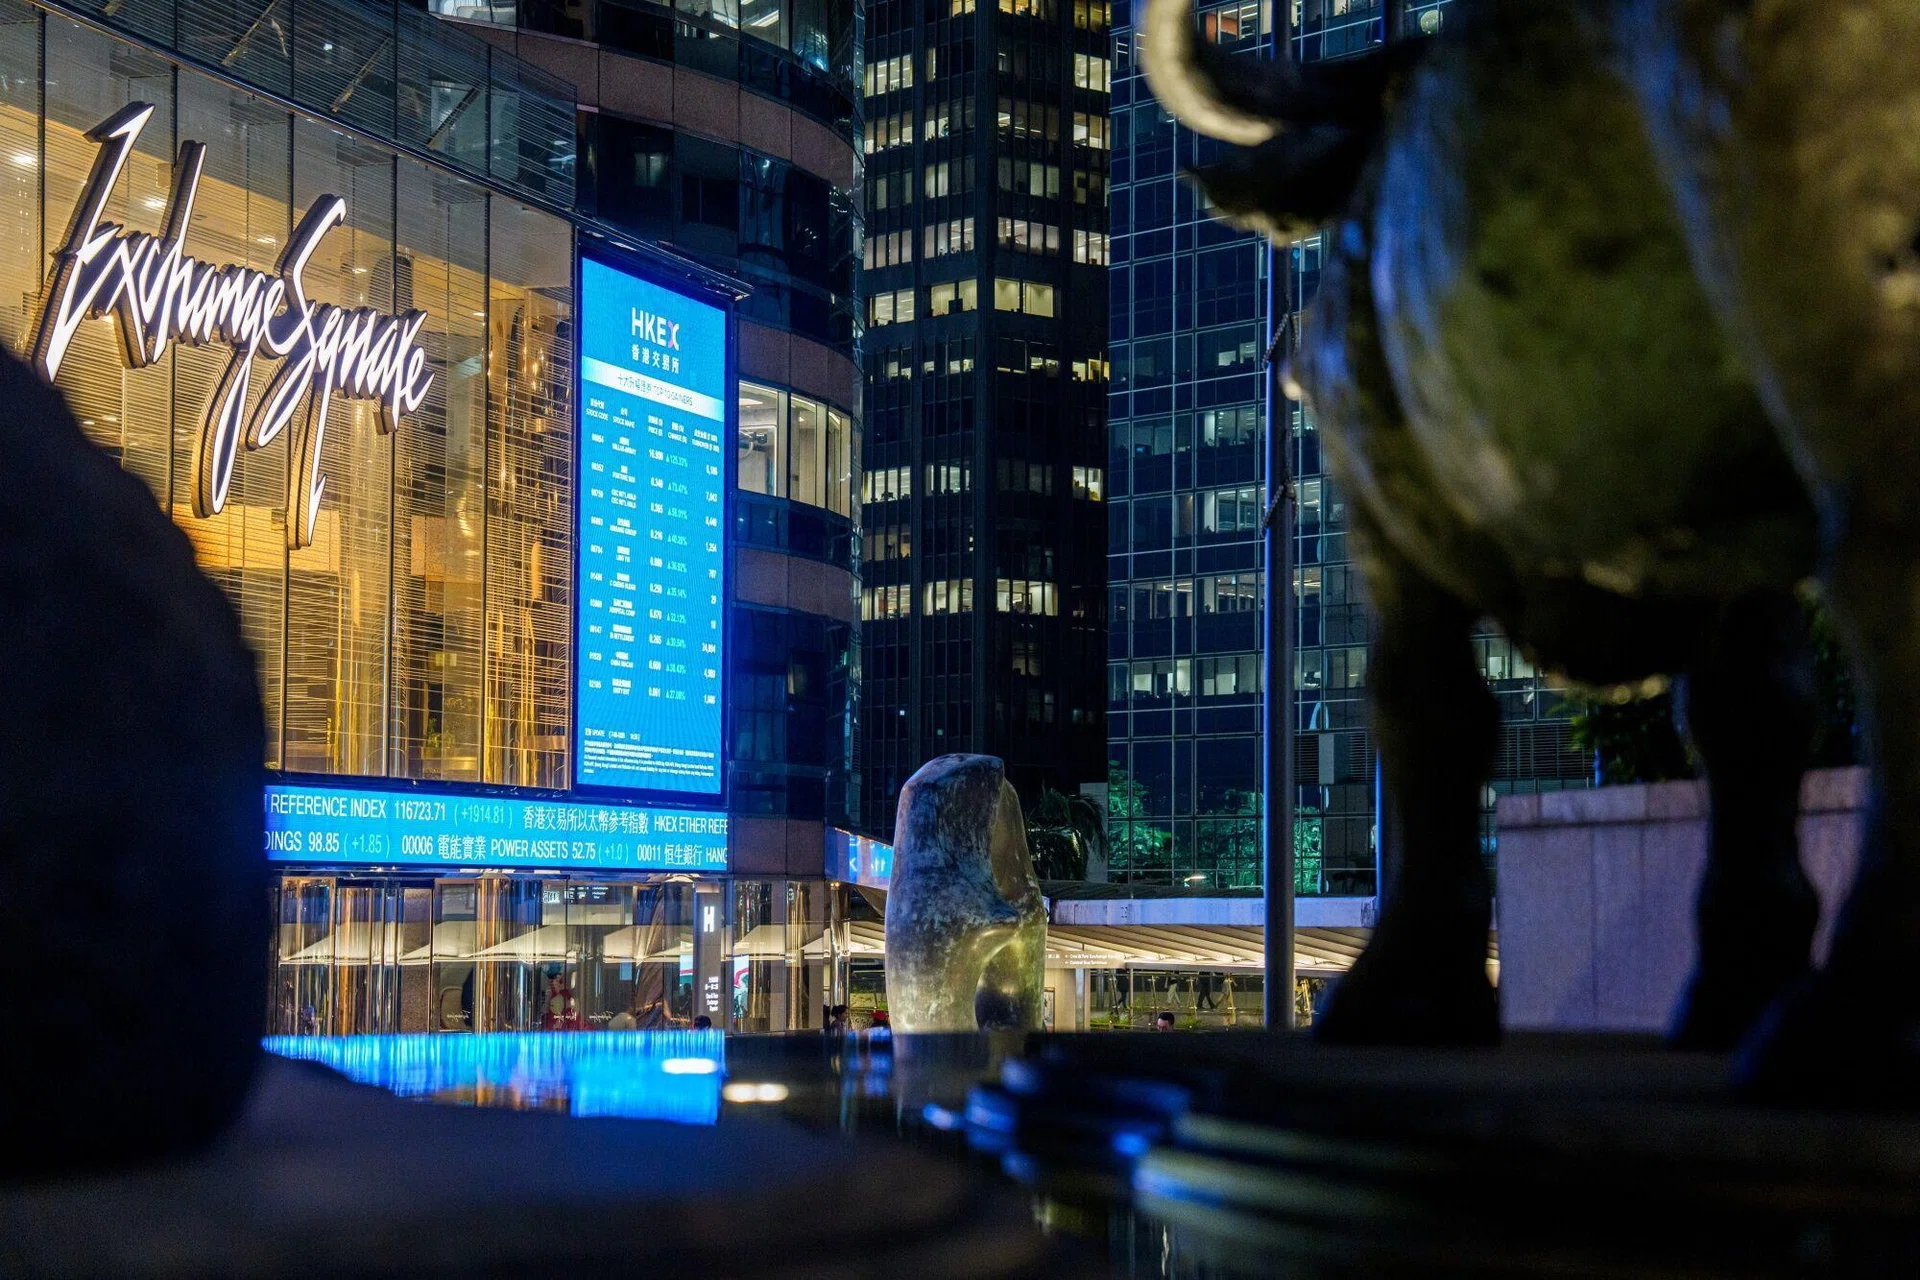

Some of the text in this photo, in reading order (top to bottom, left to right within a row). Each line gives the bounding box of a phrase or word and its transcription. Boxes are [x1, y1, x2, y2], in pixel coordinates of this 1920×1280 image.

[47, 104, 436, 547] Exchange Square
[631, 307, 680, 351] HKEX
[631, 343, 680, 374] 香港交易所
[271, 793, 348, 817] REFERENCE
[350, 798, 386, 818] INDEX
[395, 801, 446, 821] 116723.71
[654, 815, 677, 832] HKEX
[679, 817, 707, 834] ETHER
[308, 831, 339, 852] 98.85
[401, 835, 433, 855] 00006
[437, 834, 486, 860] 電能實業
[491, 838, 528, 858] POWER
[530, 840, 568, 859] ASSETS
[572, 841, 596, 860] 52.75
[637, 844, 661, 861] 00011
[664, 843, 702, 866] 恒生銀行
